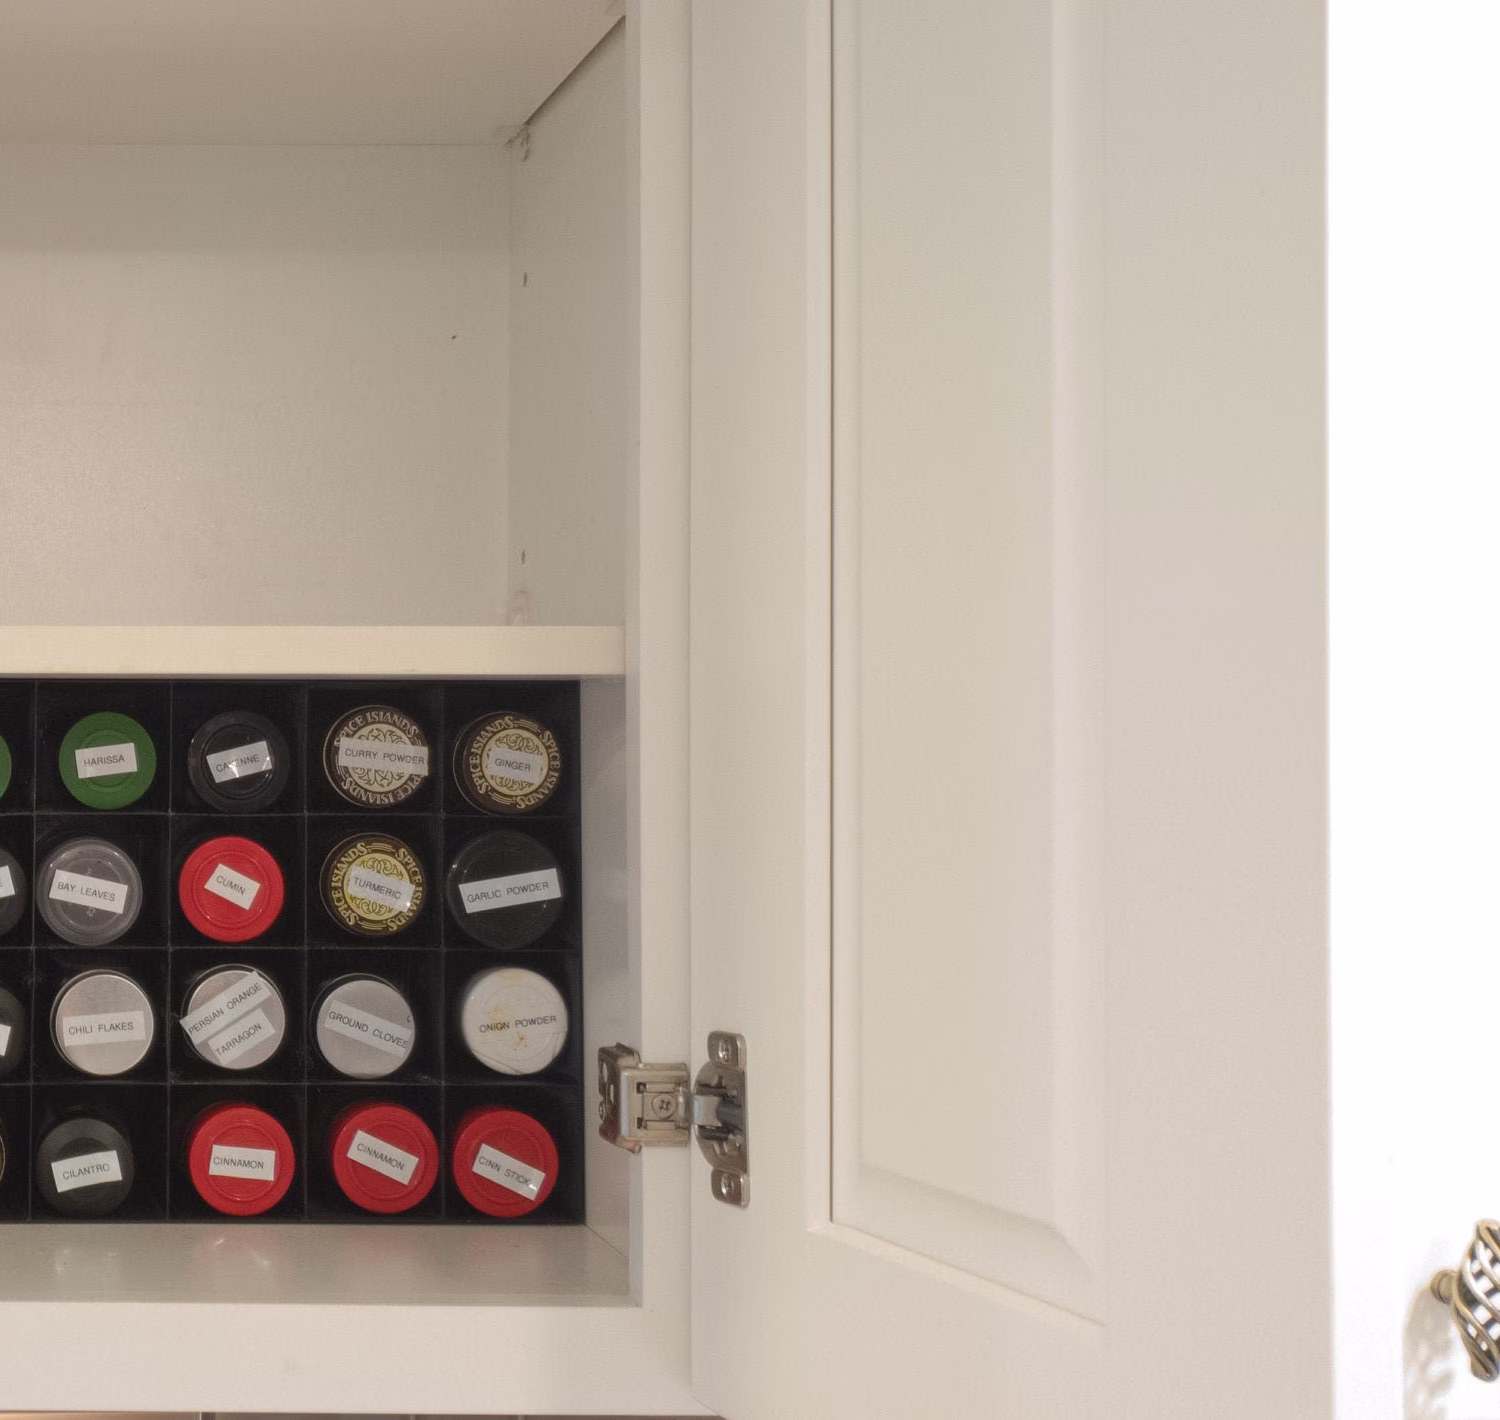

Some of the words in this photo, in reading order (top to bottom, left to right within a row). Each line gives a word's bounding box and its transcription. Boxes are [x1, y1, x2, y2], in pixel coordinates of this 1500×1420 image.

[366, 711, 418, 738] ISLANDS
[470, 715, 513, 754] ISLANDS
[83, 754, 125, 767] HARISSA
[344, 748, 378, 760] CURRY
[383, 752, 425, 765] POWDER
[539, 730, 560, 769] SPICE
[469, 755, 491, 794] SPICE
[494, 758, 531, 772] GINGER
[341, 777, 395, 804] ISLANDS
[395, 773, 424, 800] PICE
[516, 771, 559, 809] ISLANDS
[331, 842, 368, 888] ISLANDS
[395, 848, 422, 885] SPICE
[57, 881, 76, 892] BAY
[80, 886, 115, 902] LEAVES
[216, 875, 246, 896] CUMIN
[354, 877, 402, 900] TURMERIC
[466, 889, 502, 903] GARLIC
[506, 881, 549, 896] POWDER
[331, 889, 360, 926] SPICE
[188, 1008, 225, 1036] PERSIAN
[226, 982, 262, 1010] ORANGE
[68, 1025, 93, 1035] CHILI
[97, 1021, 134, 1033] FLAKES
[328, 1010, 369, 1033] GROUND
[372, 1028, 410, 1049] CLOVES
[478, 1021, 510, 1034] ONION
[514, 1015, 557, 1028] POWDER
[215, 1022, 262, 1057] TARRAGON
[213, 1156, 264, 1170] CINNAMON
[356, 1142, 405, 1171] CINNAMON
[62, 1163, 111, 1181] CILANTRO
[478, 1156, 501, 1172] CINN
[503, 1168, 531, 1187] STICK
